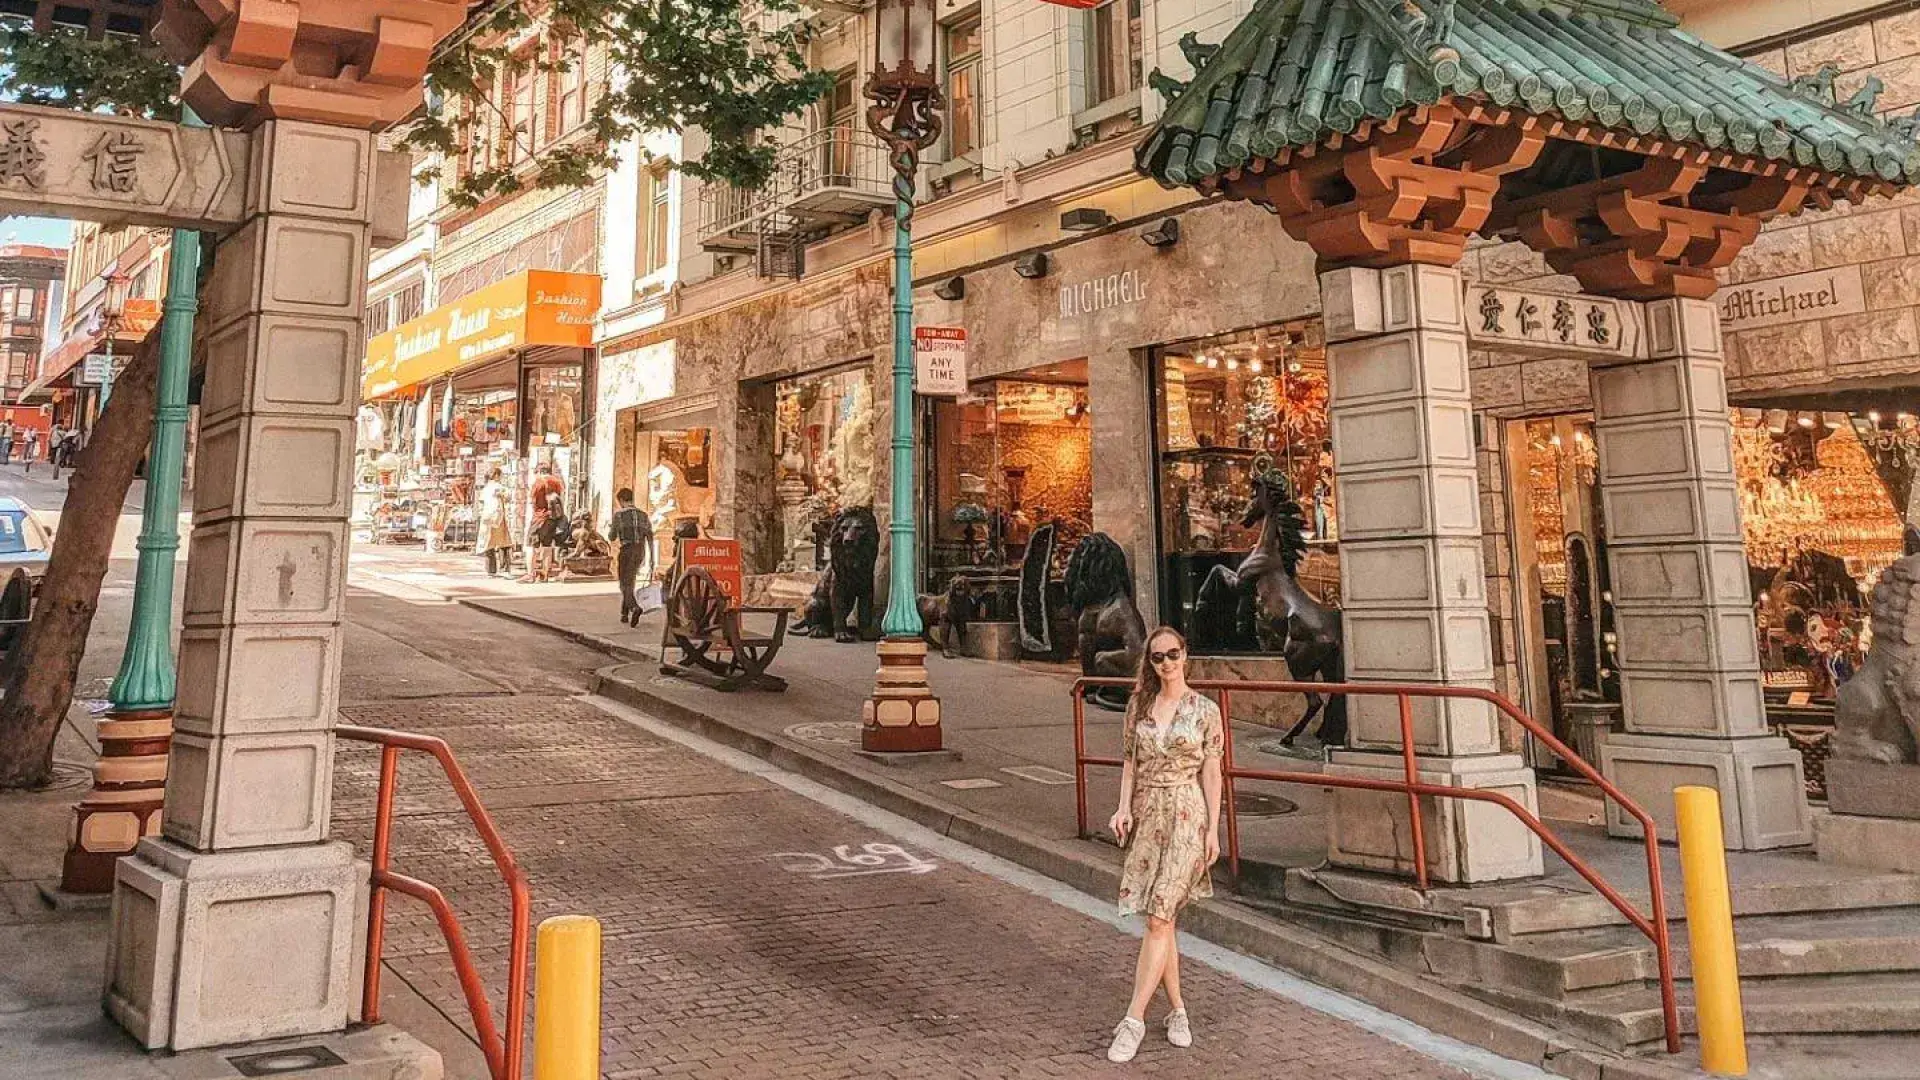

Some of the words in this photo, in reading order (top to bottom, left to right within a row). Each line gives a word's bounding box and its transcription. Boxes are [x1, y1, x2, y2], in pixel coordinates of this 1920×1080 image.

[1060, 269, 1147, 318] MICHAEL
[1720, 276, 1838, 326] Michael
[917, 338, 931, 351] NO
[930, 357, 952, 368] ANY
[929, 369, 955, 380] TIME
[693, 546, 730, 558] Michael
[768, 843, 936, 874] 269
